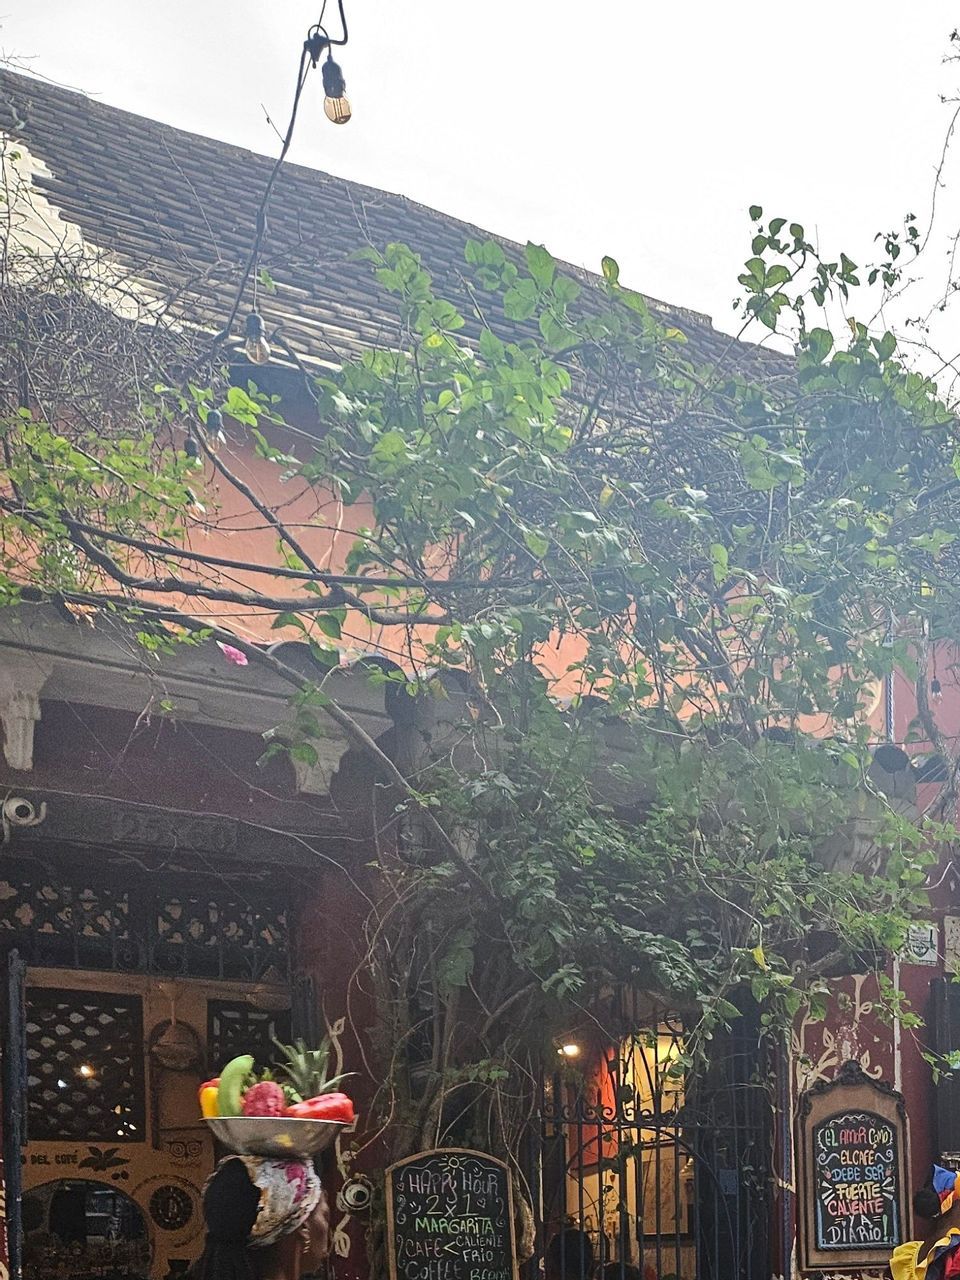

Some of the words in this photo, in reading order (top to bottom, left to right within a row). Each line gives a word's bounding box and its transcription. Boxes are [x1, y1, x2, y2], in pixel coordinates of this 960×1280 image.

[825, 1128, 838, 1146] EL
[841, 1150, 852, 1165] EL
[831, 1166, 861, 1181] DEBE
[864, 1164, 886, 1181] SER
[835, 1181, 881, 1200] FUERTE
[861, 1215, 871, 1226] A
